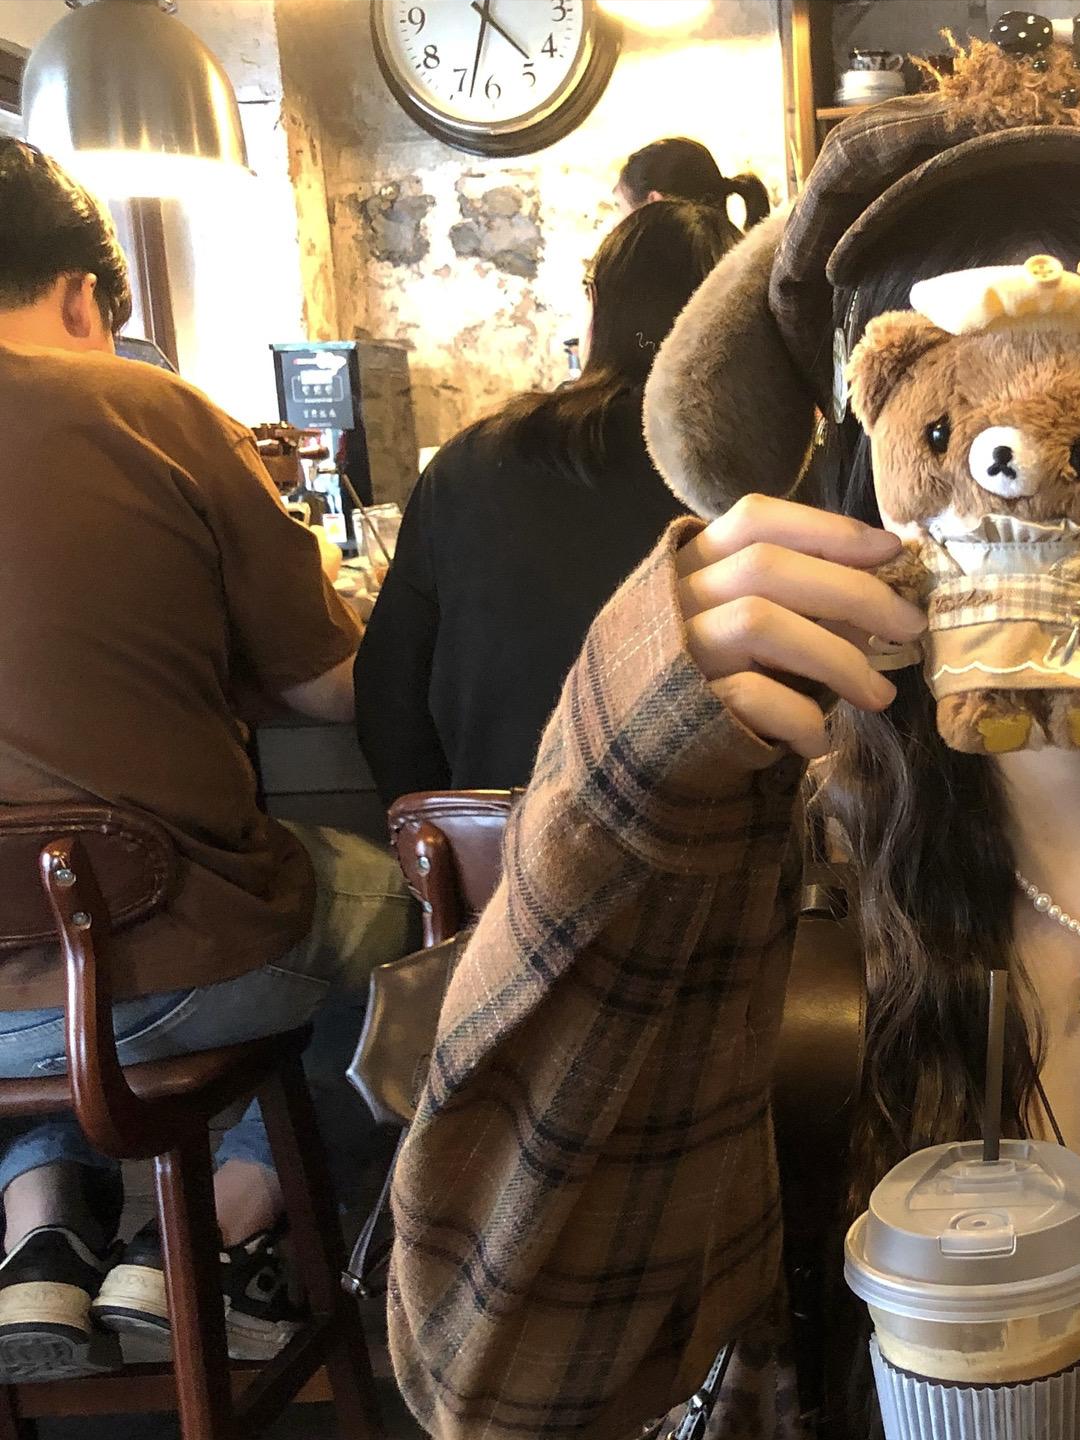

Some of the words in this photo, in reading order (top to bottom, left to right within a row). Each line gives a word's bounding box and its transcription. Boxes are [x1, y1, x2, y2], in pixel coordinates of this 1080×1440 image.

[407, 6, 426, 35] 9
[422, 44, 441, 70] 8
[541, 31, 558, 58] 4
[453, 68, 468, 92] 7
[484, 74, 502, 100] 6
[522, 63, 536, 88] 5
